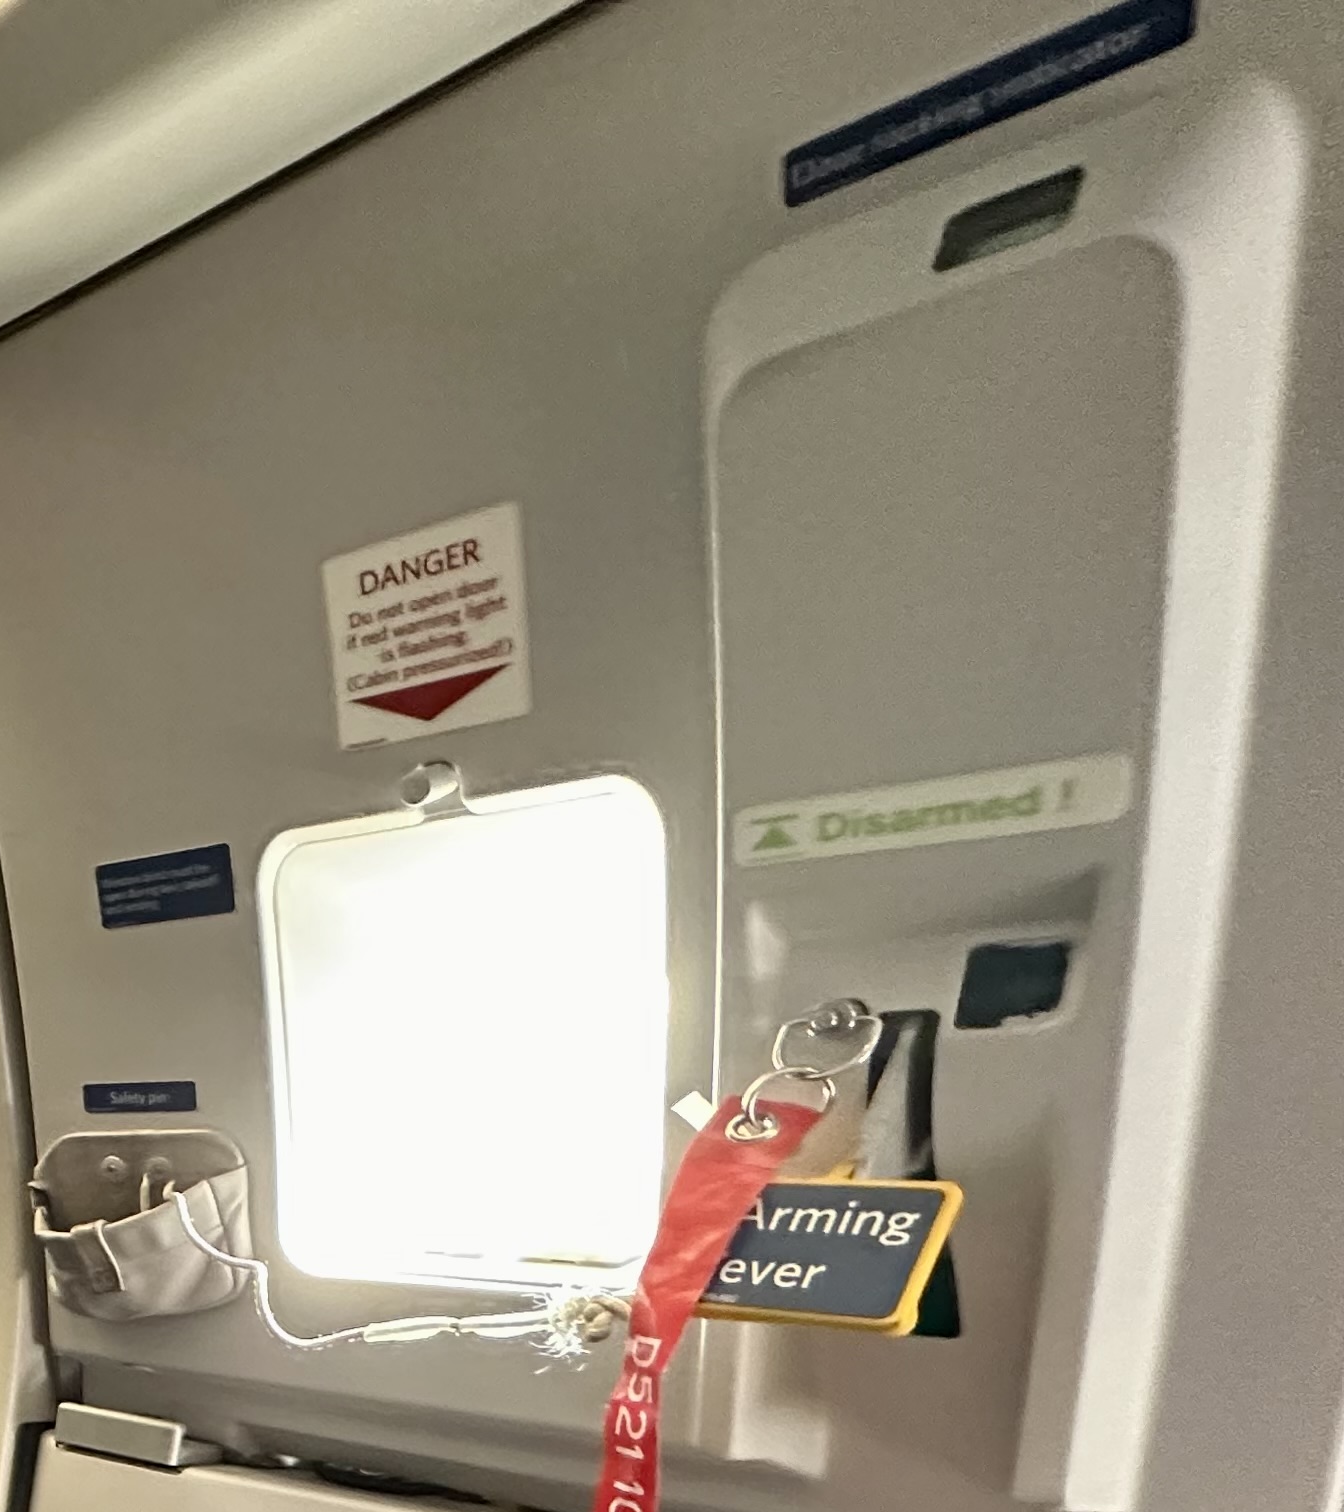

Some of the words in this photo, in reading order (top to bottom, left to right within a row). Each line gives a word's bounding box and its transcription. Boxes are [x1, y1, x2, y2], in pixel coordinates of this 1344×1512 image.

[359, 538, 481, 596] DANGER
[349, 612, 372, 629] Do
[378, 602, 404, 620] not
[410, 591, 452, 612] open
[457, 578, 498, 598] door
[817, 784, 1043, 842] Disarmed
[111, 1091, 146, 1106] Safety
[739, 1197, 920, 1246] Arming
[614, 1334, 662, 1460] D521
